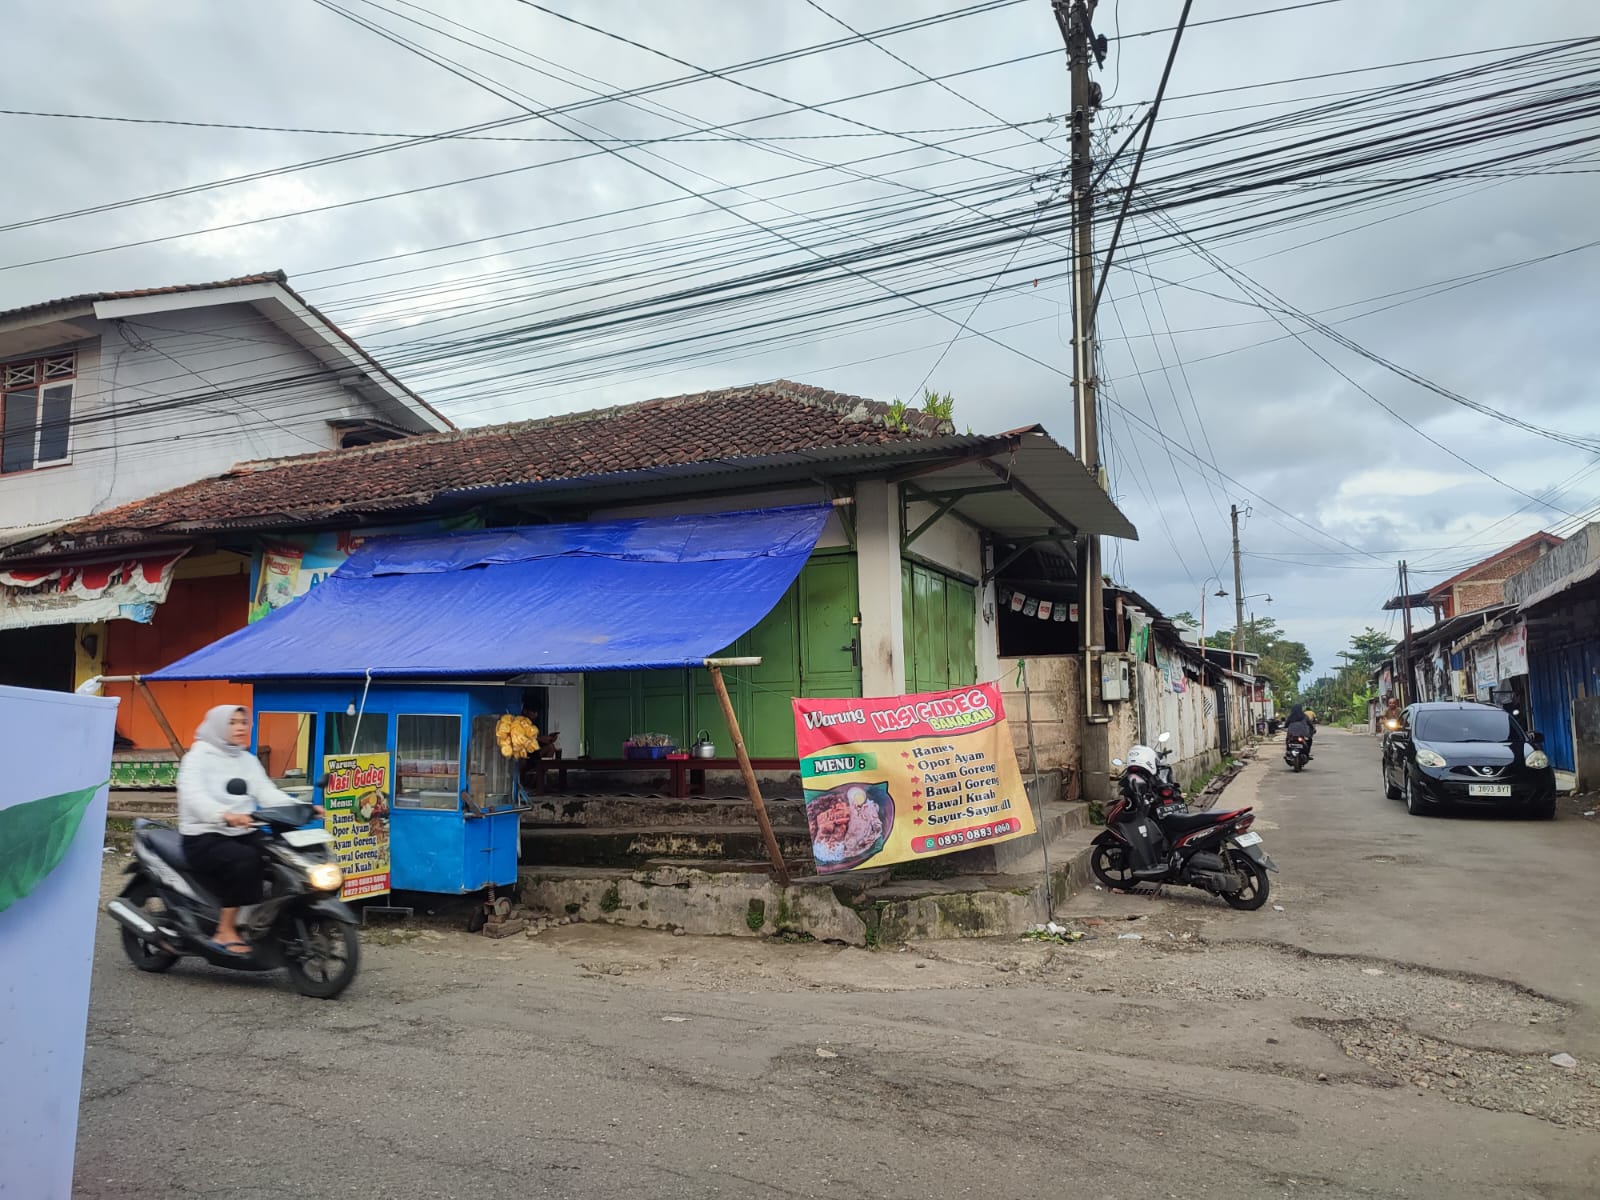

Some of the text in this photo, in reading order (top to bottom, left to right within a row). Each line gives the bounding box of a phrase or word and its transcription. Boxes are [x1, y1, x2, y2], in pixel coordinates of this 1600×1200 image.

[803, 690, 987, 733] Warung NASI GUDEG
[912, 744, 954, 758] Rames
[328, 760, 357, 770] Warung
[813, 757, 856, 774] MENU
[917, 752, 985, 770] Opor Ayam
[327, 764, 386, 794] Nasi Gudeg
[924, 763, 996, 783] Ayam Goreng
[925, 781, 962, 797] Bawal
[926, 795, 963, 811] Bawal
[333, 814, 355, 824] Rames
[333, 824, 370, 837] Opor Ayam
[938, 832, 963, 846] 0895
[966, 827, 992, 840] 0883
[333, 836, 377, 851] Ayam Goreng
[336, 849, 378, 862] awal Goreng
[355, 861, 372, 873] Kuah
